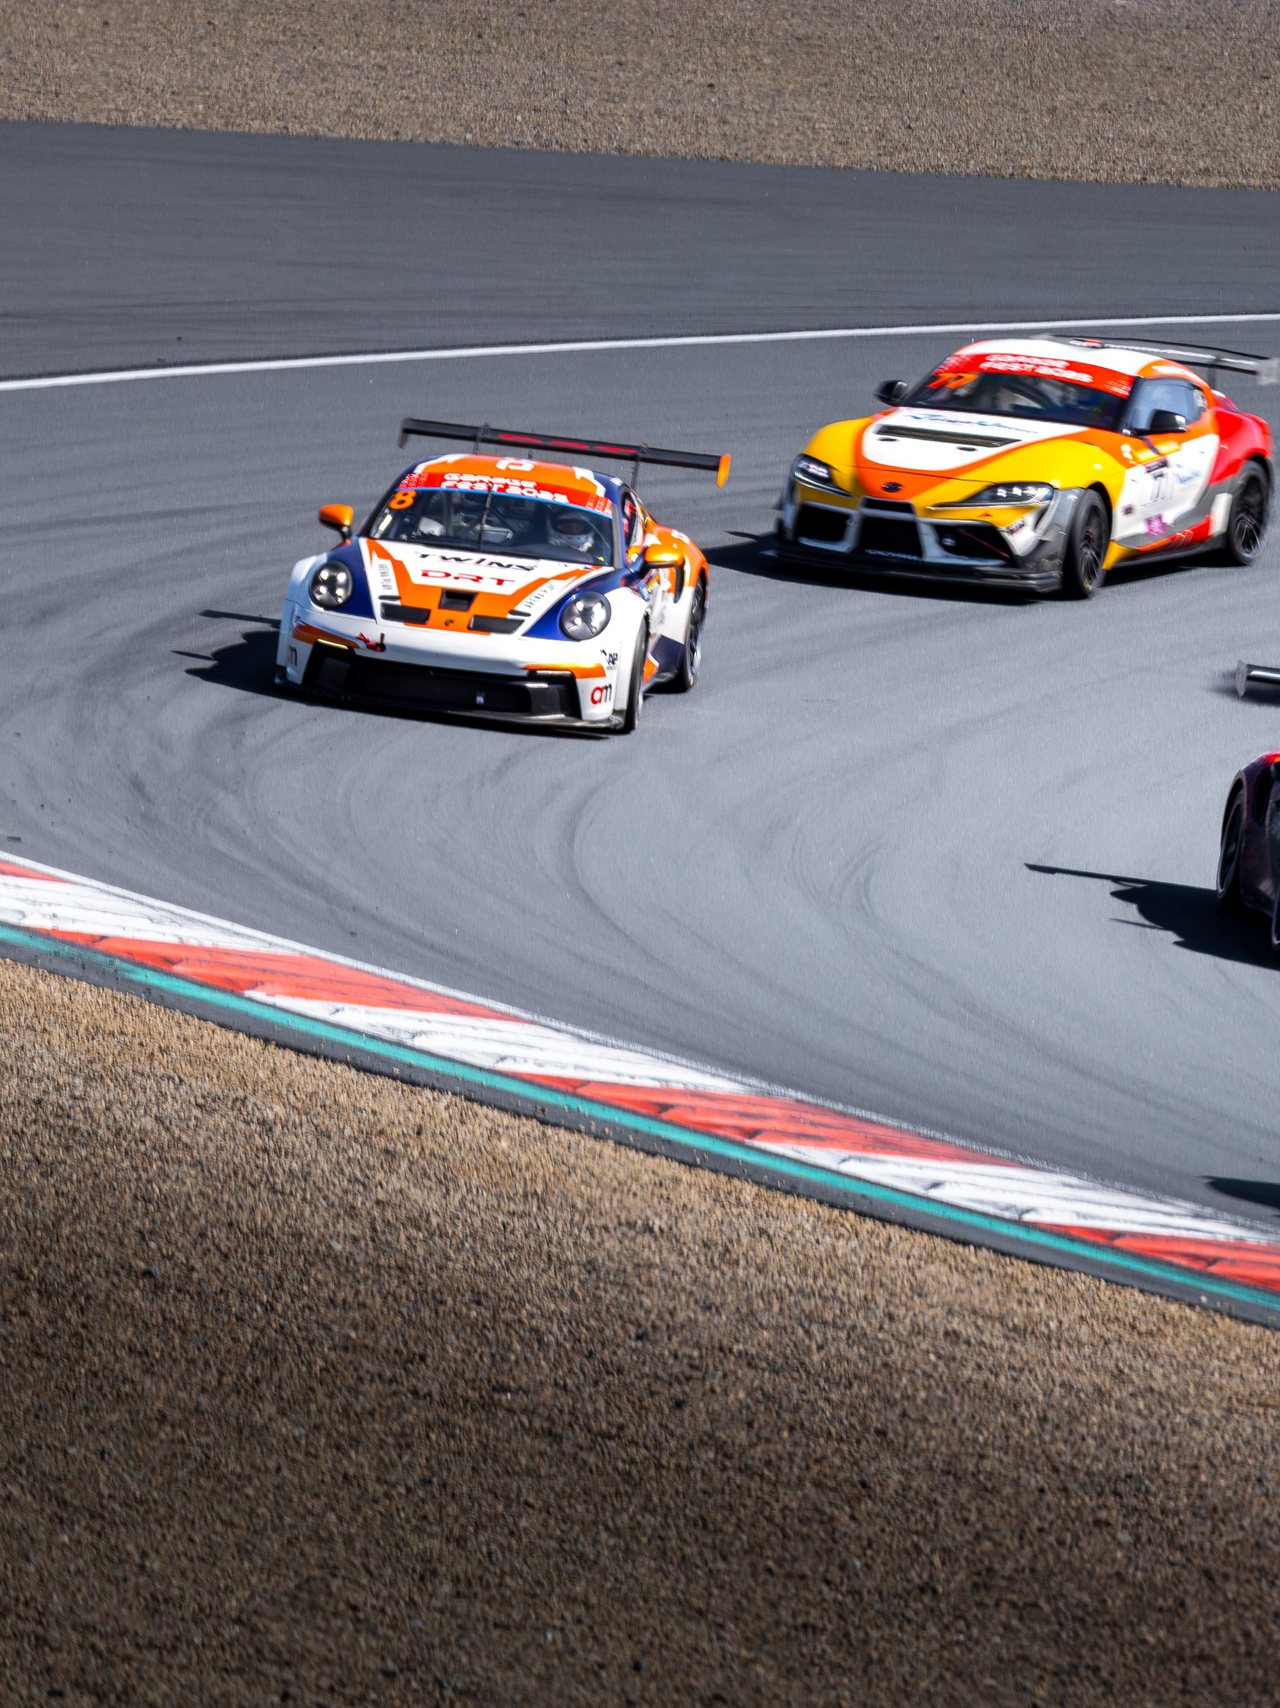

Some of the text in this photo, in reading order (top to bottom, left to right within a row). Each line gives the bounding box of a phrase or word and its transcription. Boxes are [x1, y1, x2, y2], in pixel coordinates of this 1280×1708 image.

[926, 372, 979, 389] 77
[389, 490, 417, 510] 8
[506, 485, 569, 503] 2025
[414, 551, 537, 572] TWINS
[421, 569, 516, 586] DRT
